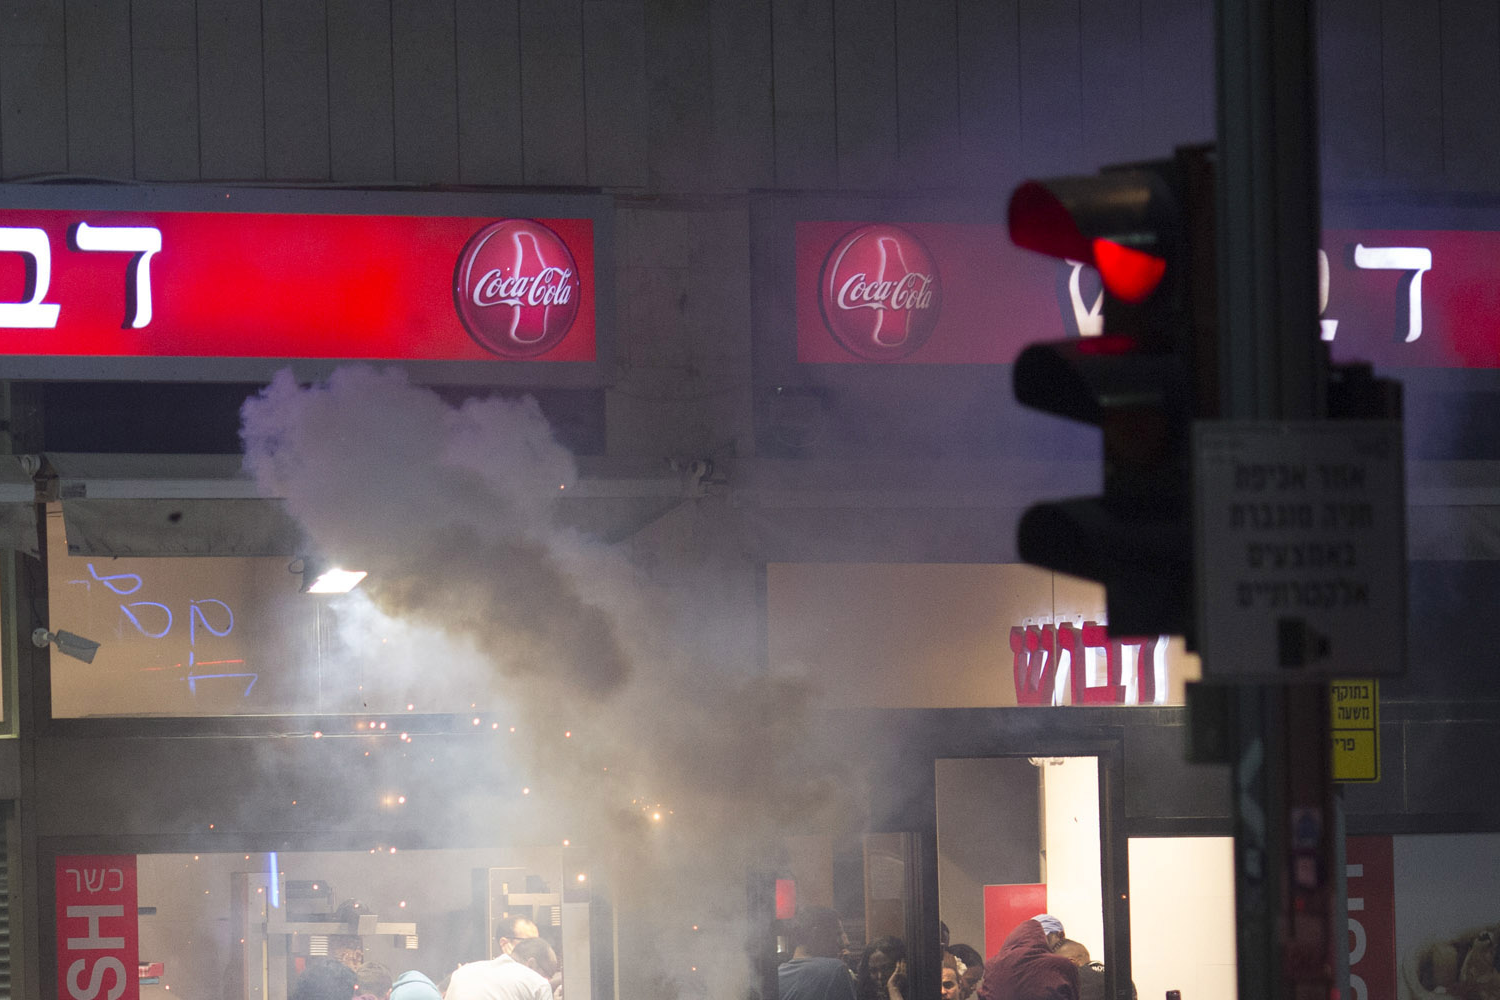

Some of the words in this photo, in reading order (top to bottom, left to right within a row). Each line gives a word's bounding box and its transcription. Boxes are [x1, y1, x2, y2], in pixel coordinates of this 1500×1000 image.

[473, 267, 573, 307] Coca-Cola
[837, 271, 934, 310] Coca-Cola
[1334, 738, 1356, 752] פרי
[66, 868, 125, 893] כשר
